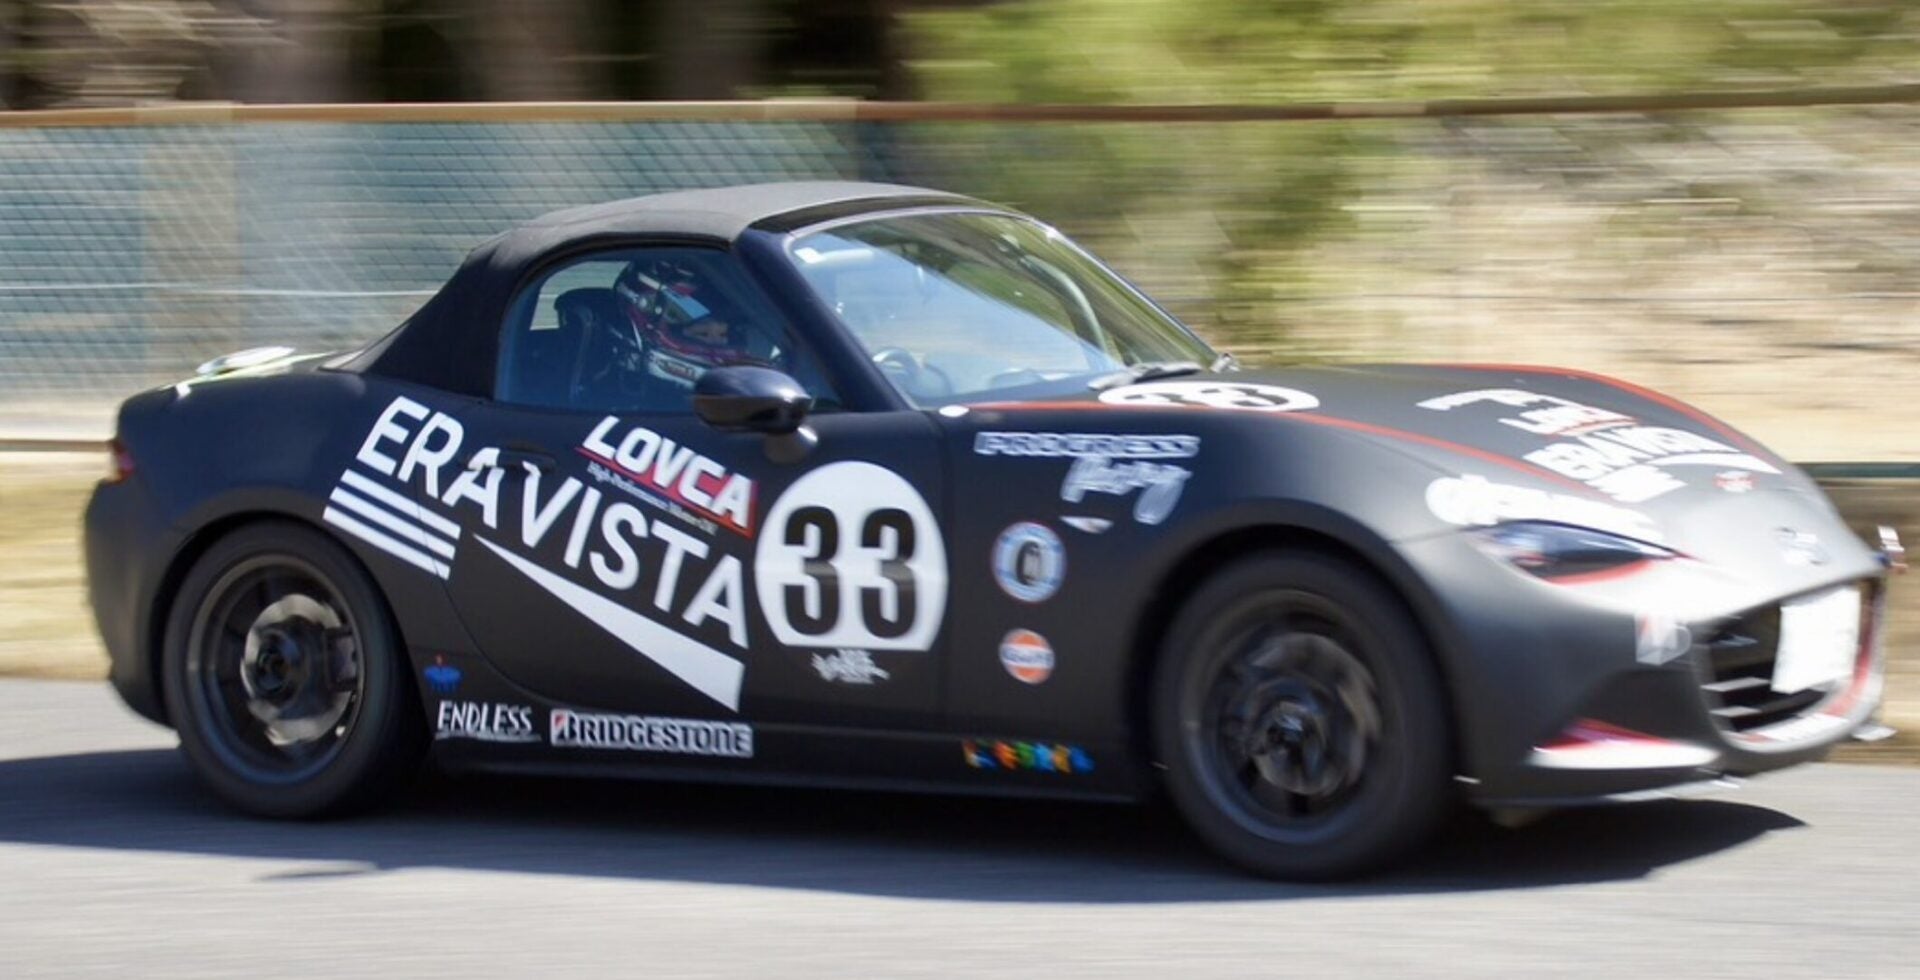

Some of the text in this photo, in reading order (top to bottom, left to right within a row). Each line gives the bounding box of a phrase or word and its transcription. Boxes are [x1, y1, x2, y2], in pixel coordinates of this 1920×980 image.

[356, 395, 749, 650] ERAVISTA
[582, 414, 752, 529] LOVCA
[783, 505, 917, 640] 33
[437, 701, 534, 733] ENDLESS
[553, 709, 751, 757] BRIDGESTONE
